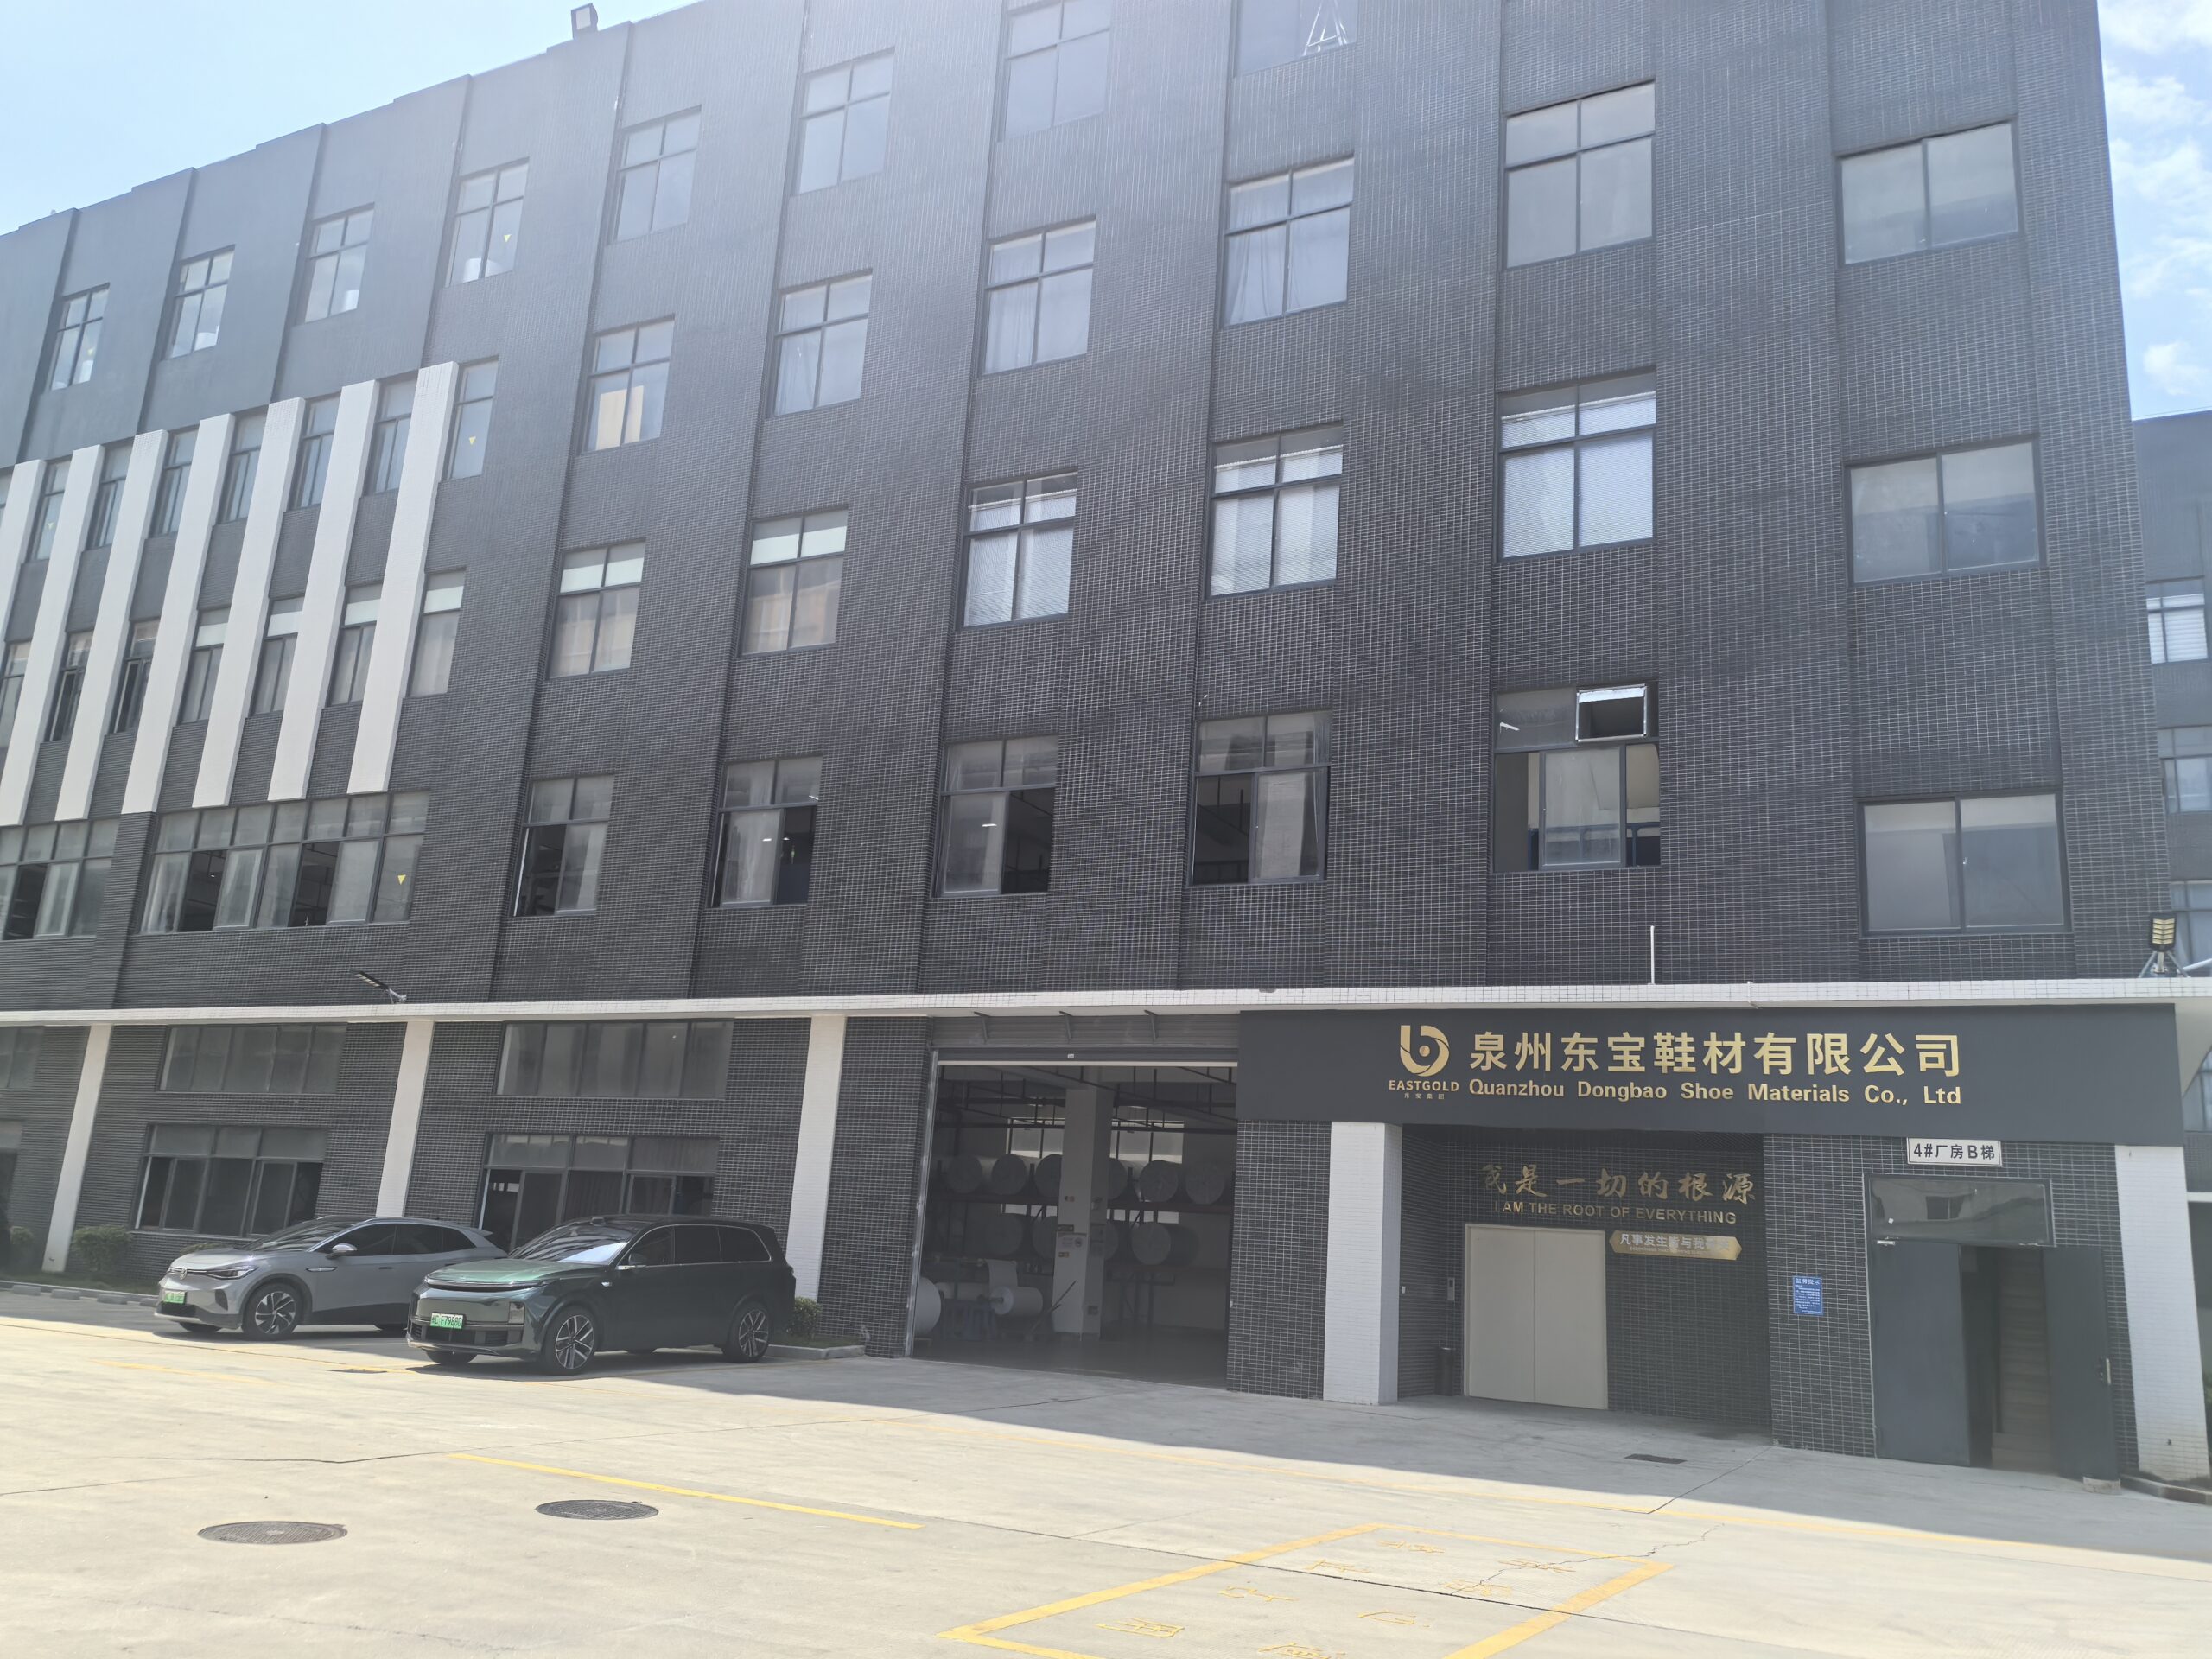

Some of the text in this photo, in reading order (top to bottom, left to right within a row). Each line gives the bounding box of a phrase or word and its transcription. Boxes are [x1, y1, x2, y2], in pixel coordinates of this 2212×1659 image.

[1469, 1032, 1961, 1077] 泉州东宝鞋材有限公司
[1389, 1080, 1459, 1092] EASTGOLD
[1469, 1077, 1962, 1105] Quanzhou Dongbao Shoe Materials Co., Ltd
[1912, 1142, 1996, 1160] 4#厂房B梯
[1482, 1164, 1756, 1205] 我是一切的根源
[1503, 1201, 1524, 1213] AM
[1529, 1202, 1557, 1215] THE
[1562, 1204, 1605, 1217] ROOT
[1610, 1206, 1630, 1217] OF
[1636, 1208, 1737, 1224] EVERYTHING
